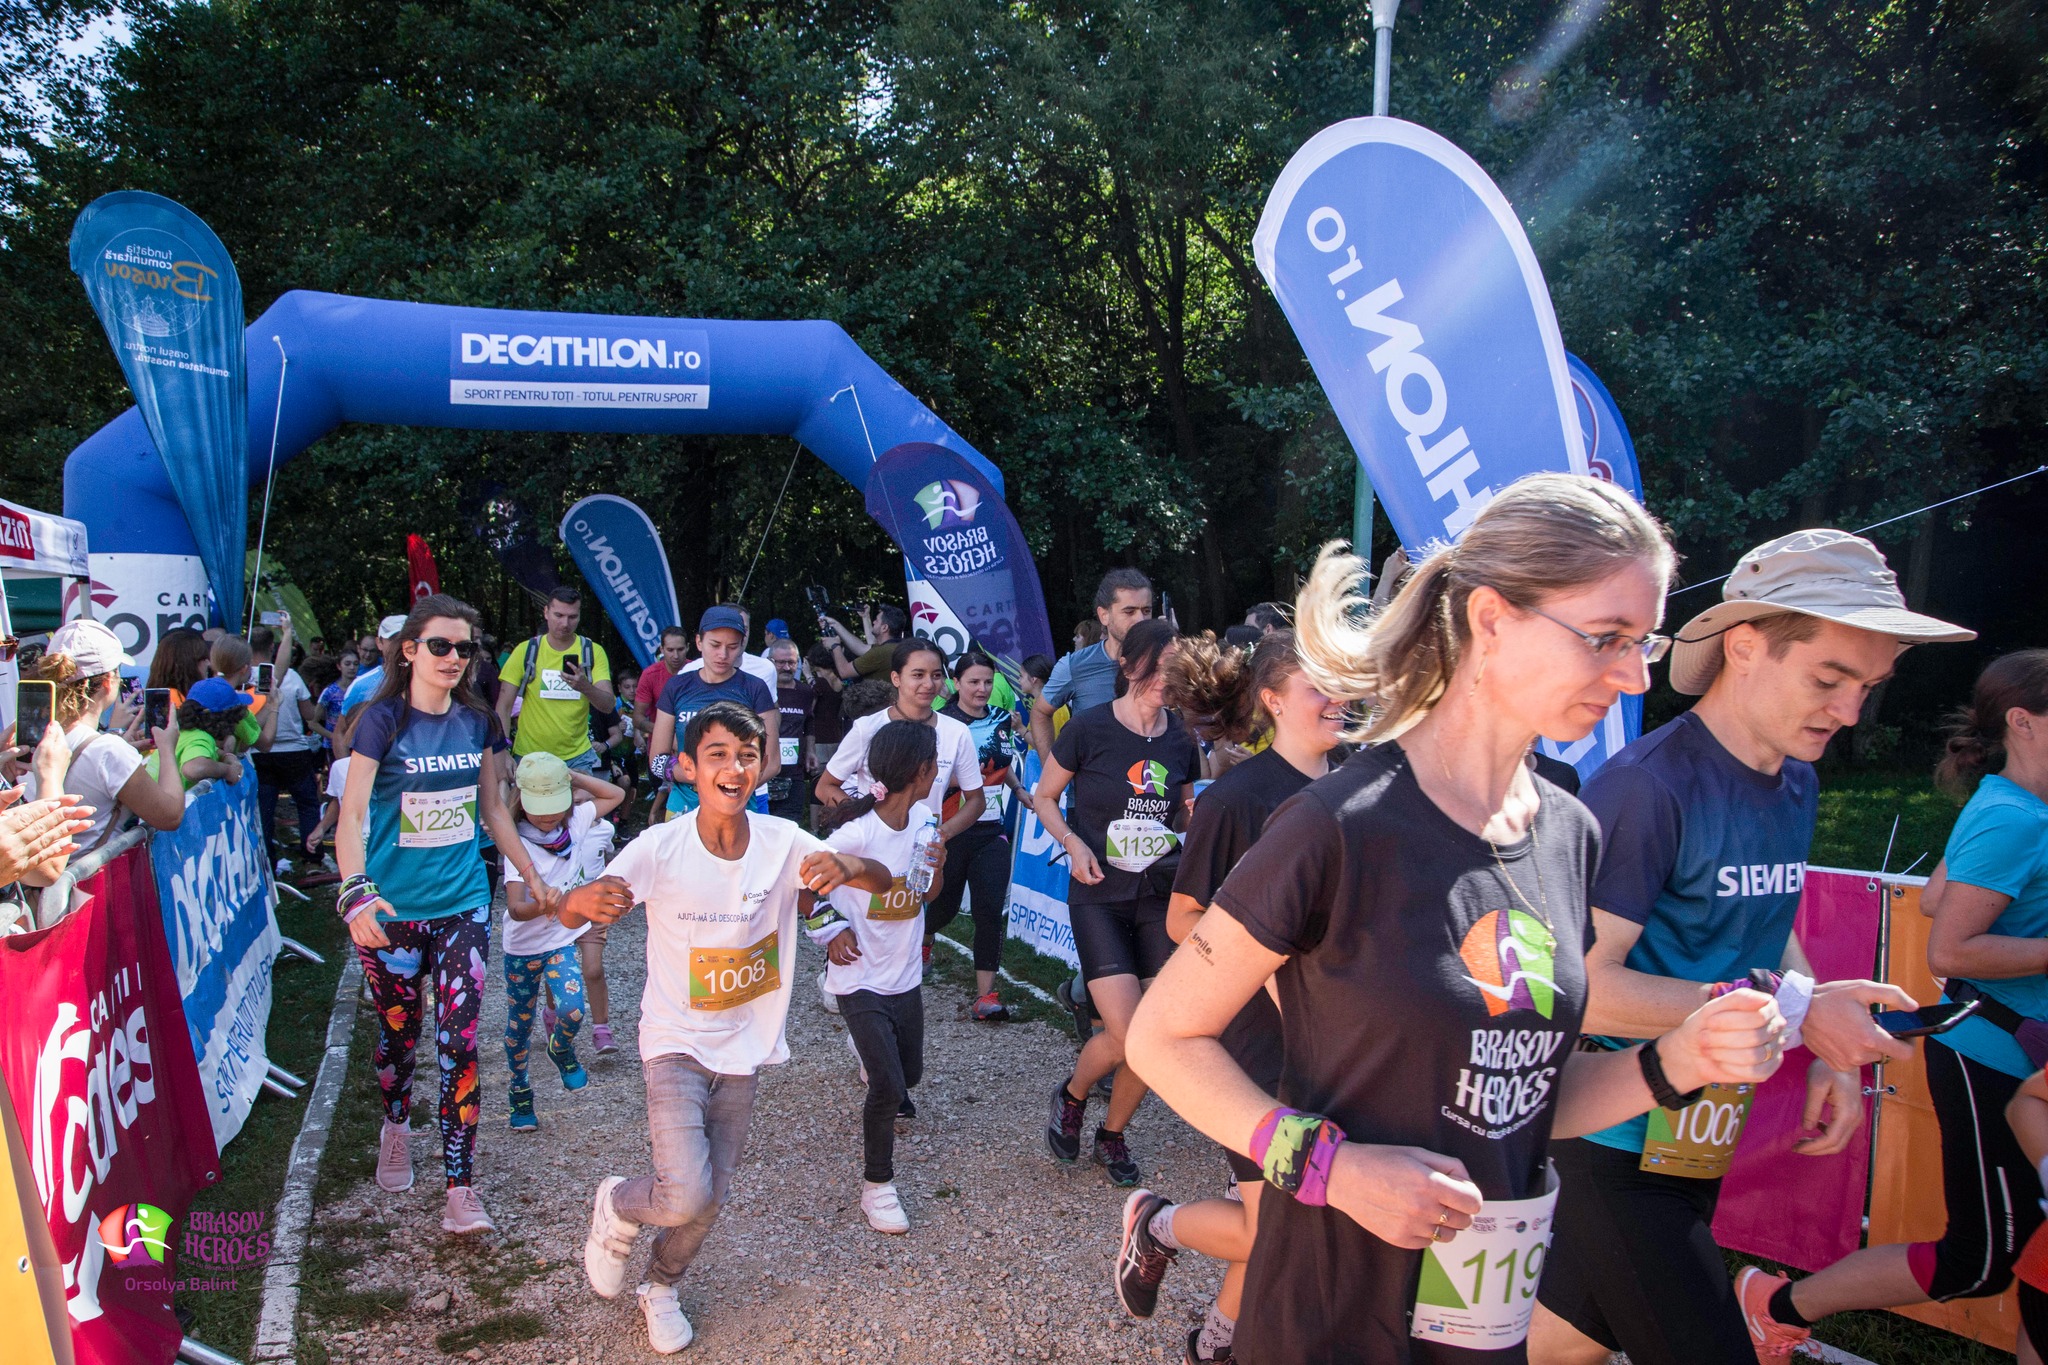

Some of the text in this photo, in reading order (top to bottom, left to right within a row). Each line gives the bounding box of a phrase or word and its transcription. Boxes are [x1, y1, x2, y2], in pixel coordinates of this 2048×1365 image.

[461, 333, 701, 369] DECATHLON.ro
[464, 388, 501, 400] SPORT
[504, 390, 549, 401] PENTRU
[582, 391, 616, 402] TOTUL
[618, 392, 662, 403] PENTRU
[663, 393, 698, 403] SPORT
[0, 515, 31, 550] zin
[414, 806, 464, 832] 1225
[1119, 836, 1166, 857] 1132
[704, 958, 766, 994] 1008
[1455, 1067, 1557, 1125] HEROES
[1441, 1105, 1471, 1129] Cursa
[1471, 1125, 1486, 1136] cu
[1463, 1242, 1545, 1304] 119
